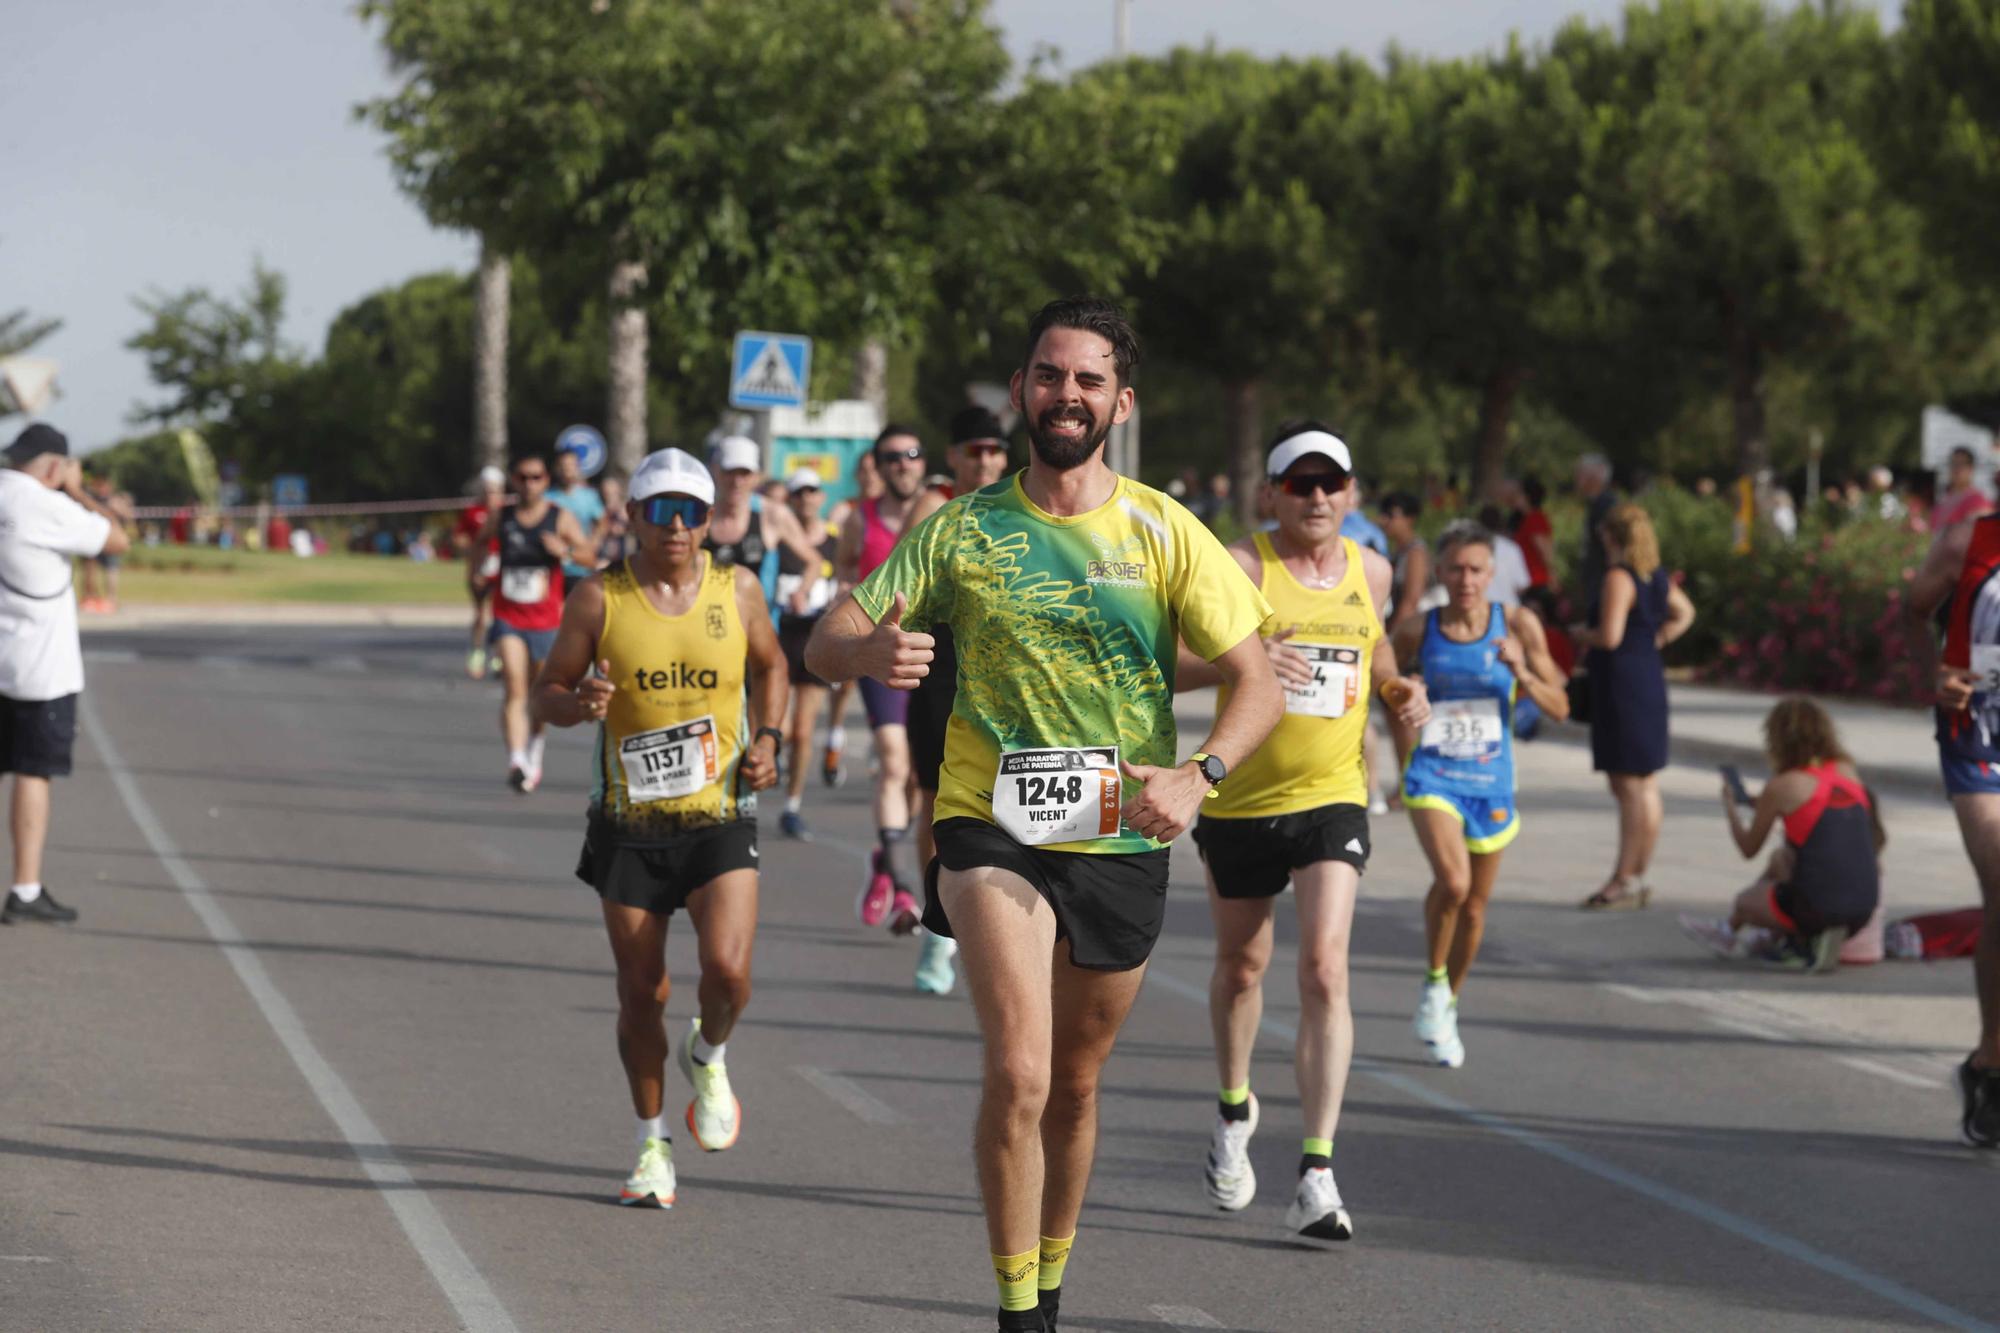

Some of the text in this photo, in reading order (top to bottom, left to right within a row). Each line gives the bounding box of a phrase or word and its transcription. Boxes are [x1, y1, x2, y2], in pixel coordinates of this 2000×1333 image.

[1087, 561, 1147, 579] PAROTET
[635, 662, 717, 691] teika
[641, 745, 684, 773] 1137
[1026, 753, 1061, 762] MARATÓN
[1031, 761, 1062, 769] PATERNA
[1016, 775, 1082, 806] 1248
[1104, 779, 1116, 799] BOX
[1029, 809, 1068, 822] VICENT
